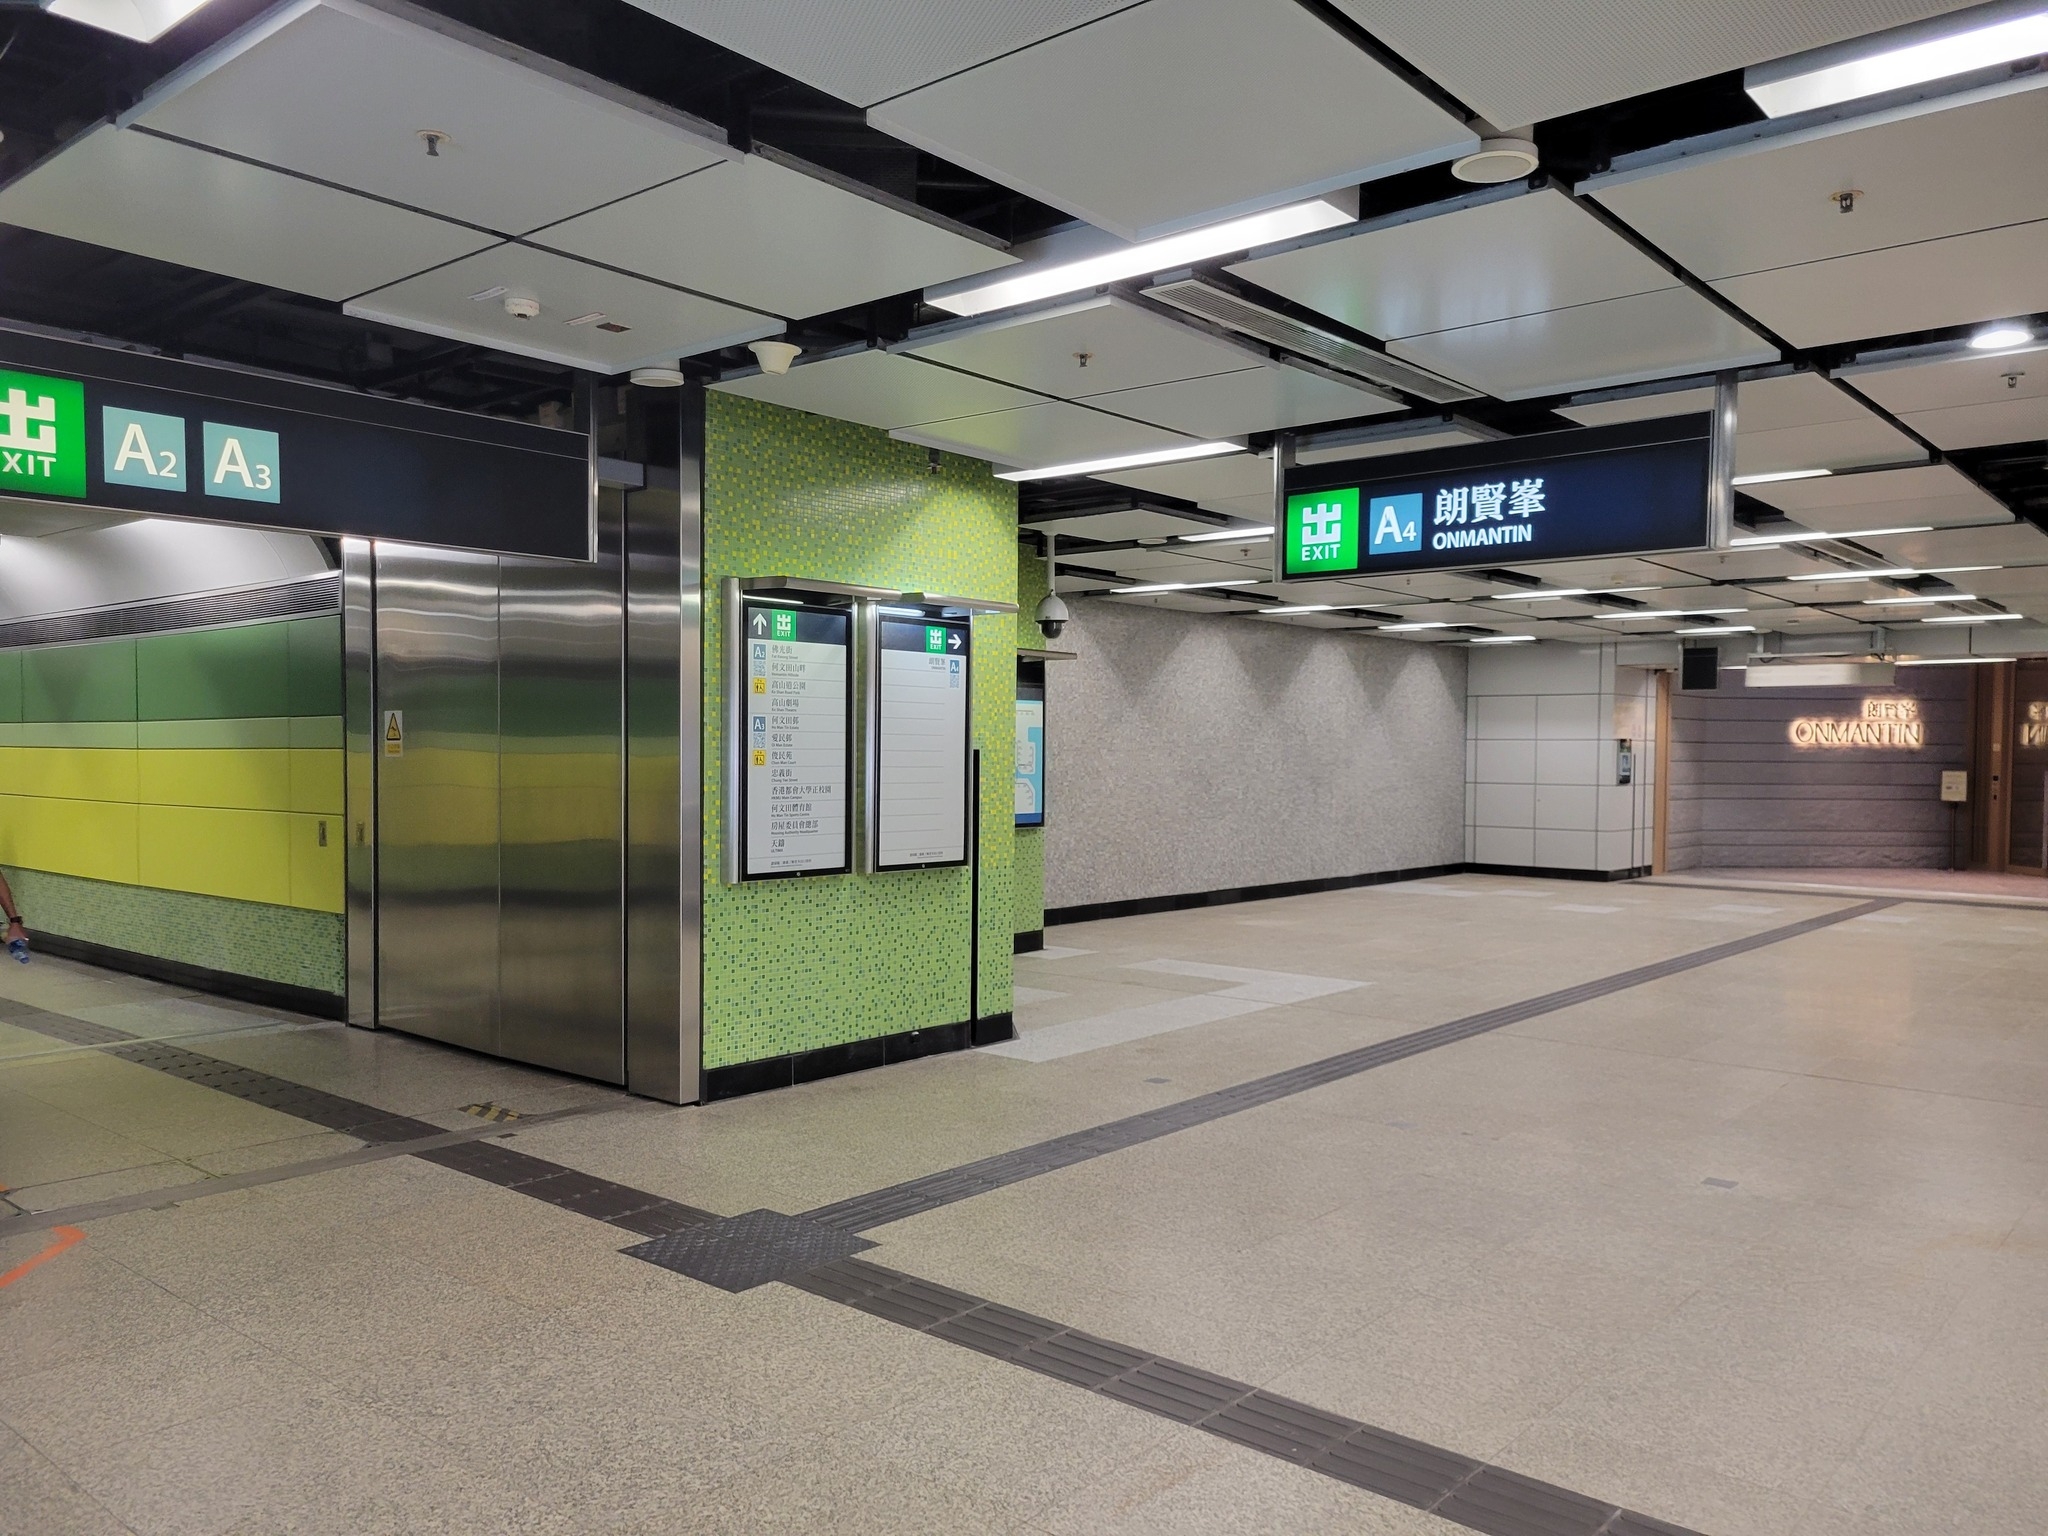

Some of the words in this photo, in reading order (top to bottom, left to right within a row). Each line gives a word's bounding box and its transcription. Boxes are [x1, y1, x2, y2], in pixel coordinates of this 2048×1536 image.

[113, 423, 178, 478] A2
[213, 437, 272, 490] A3
[2, 451, 57, 477] XIT
[1434, 477, 1546, 526] 朗賢峯
[1301, 503, 1342, 545] 出
[1374, 505, 1417, 545] A4
[1433, 525, 1532, 550] ONMANTIN
[1301, 544, 1341, 561] EXIT
[754, 646, 765, 658] A2
[754, 719, 765, 730] A3
[1796, 721, 1921, 745] ONMANTIN
